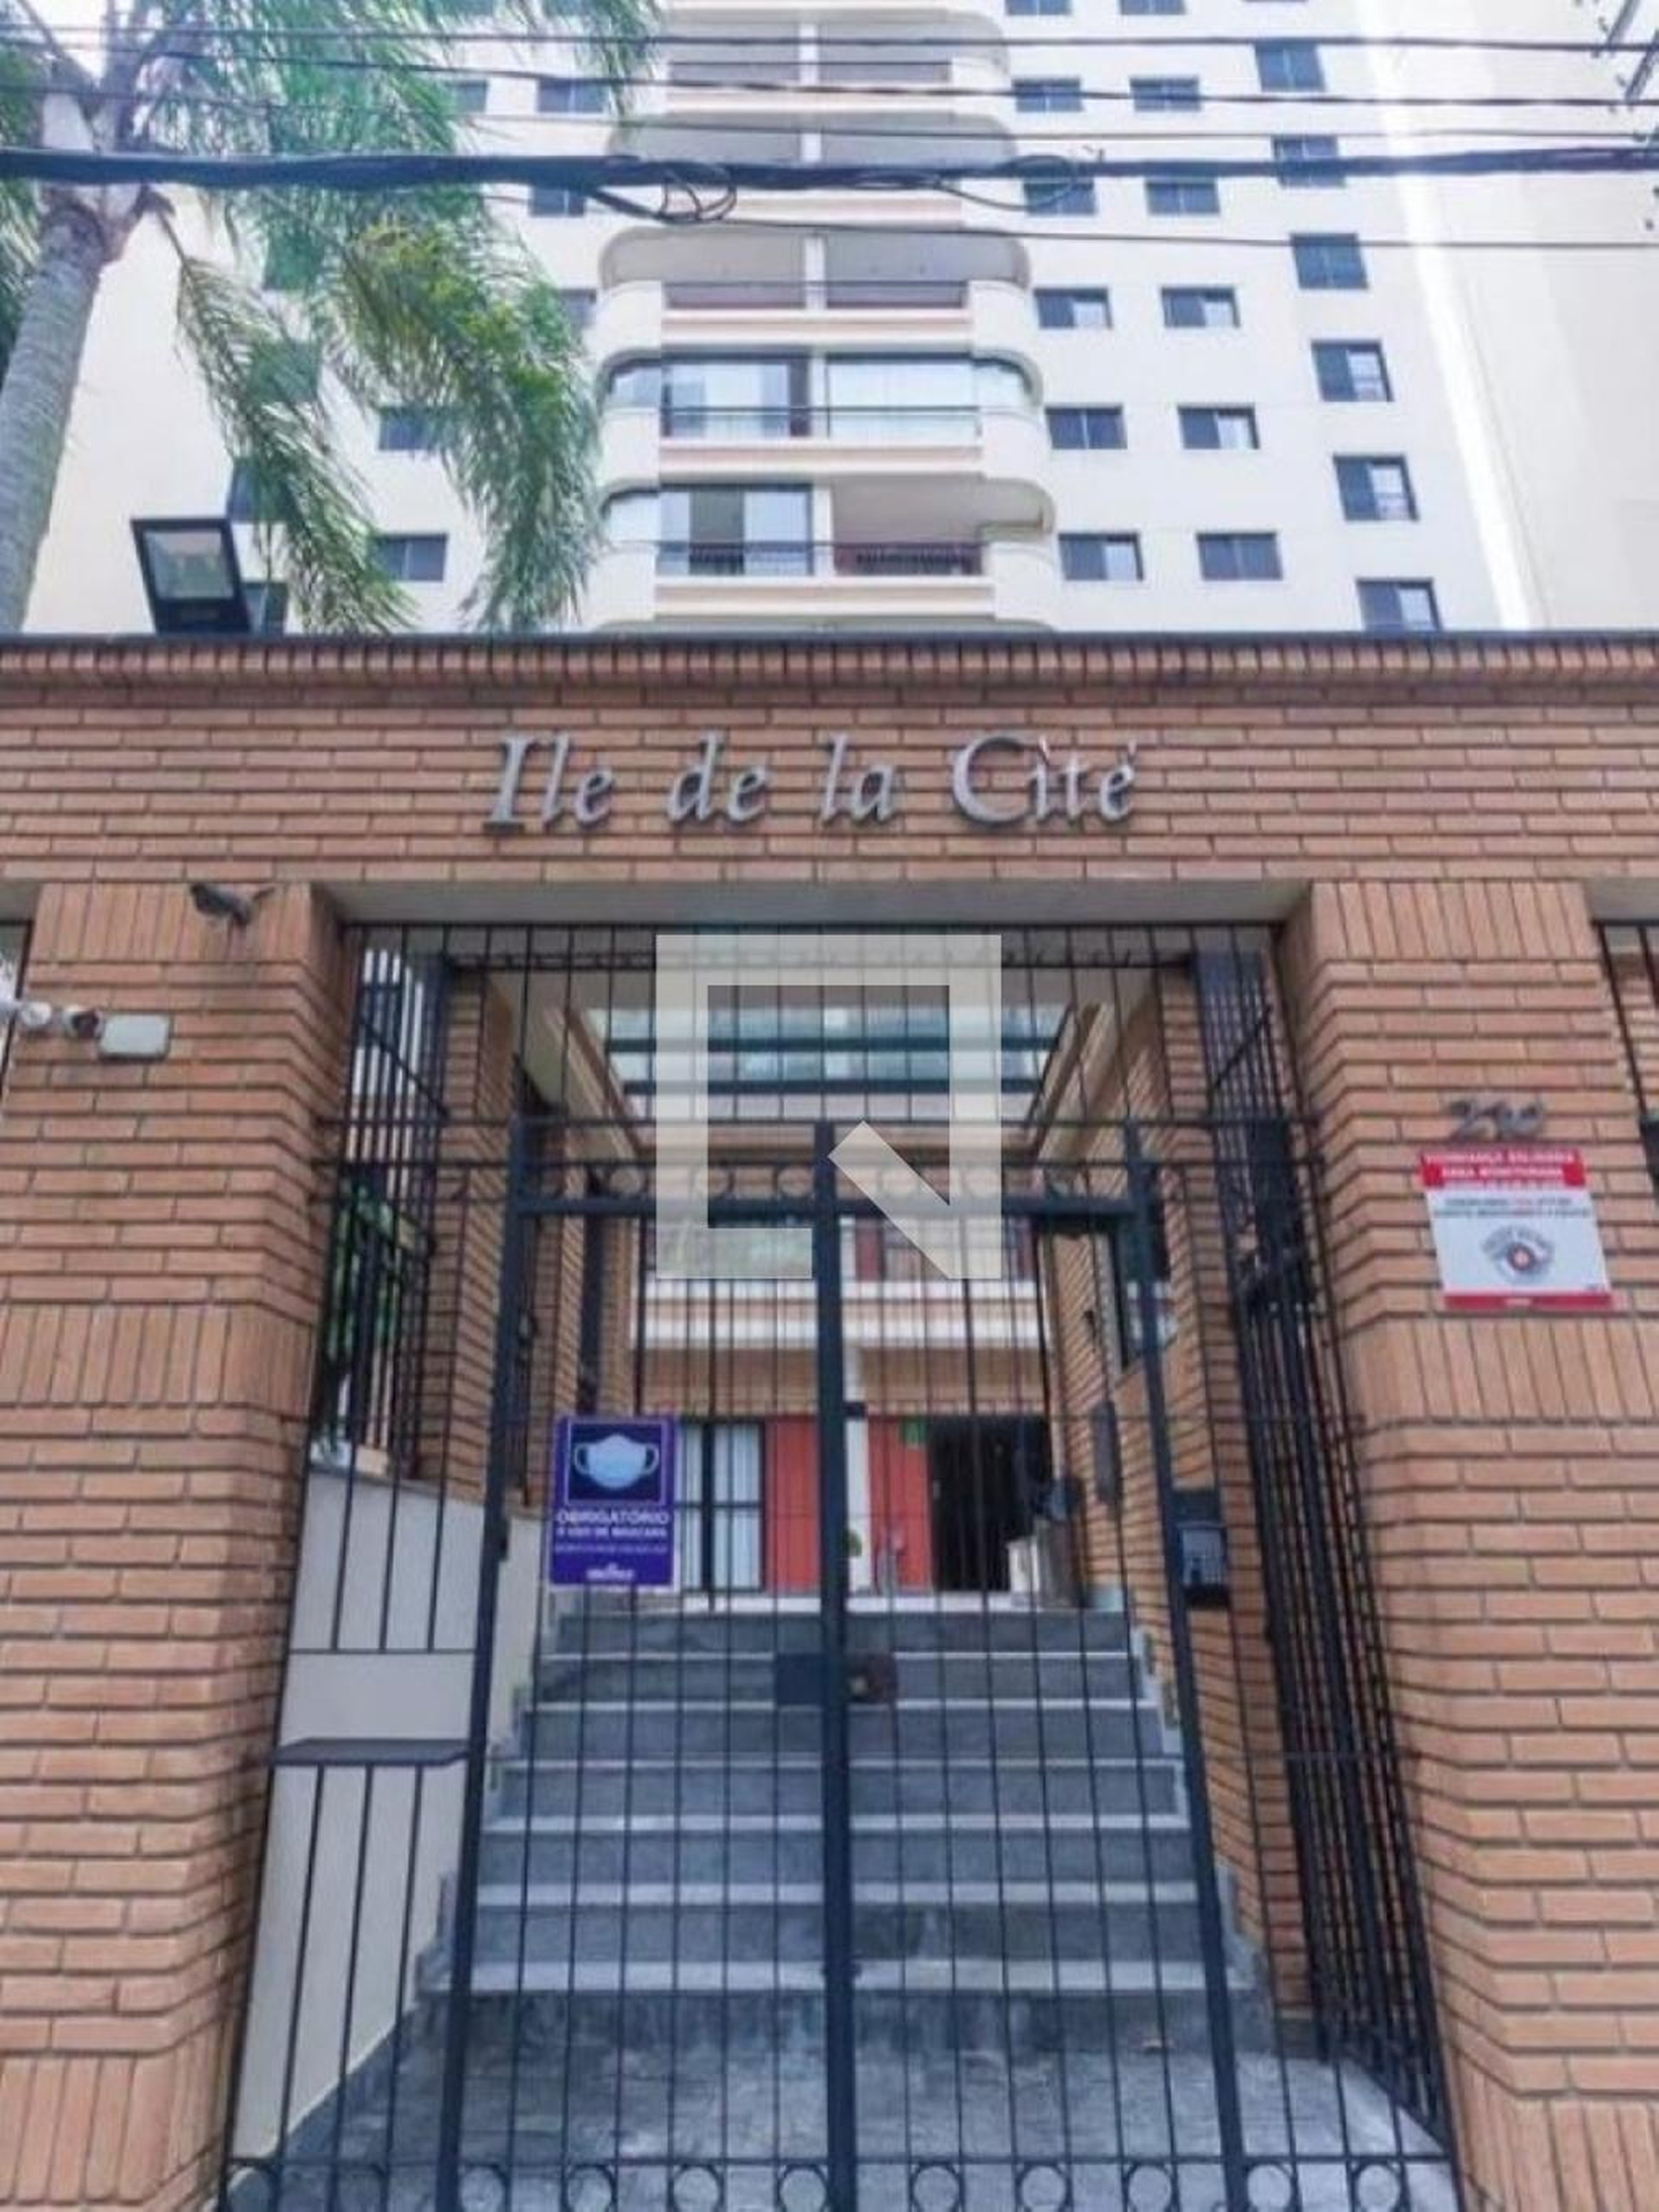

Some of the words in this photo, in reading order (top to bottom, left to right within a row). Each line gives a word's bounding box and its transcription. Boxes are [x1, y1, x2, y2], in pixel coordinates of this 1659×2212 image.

[484, 732, 613, 832] Ile
[667, 730, 767, 823] de
[820, 731, 896, 823] la
